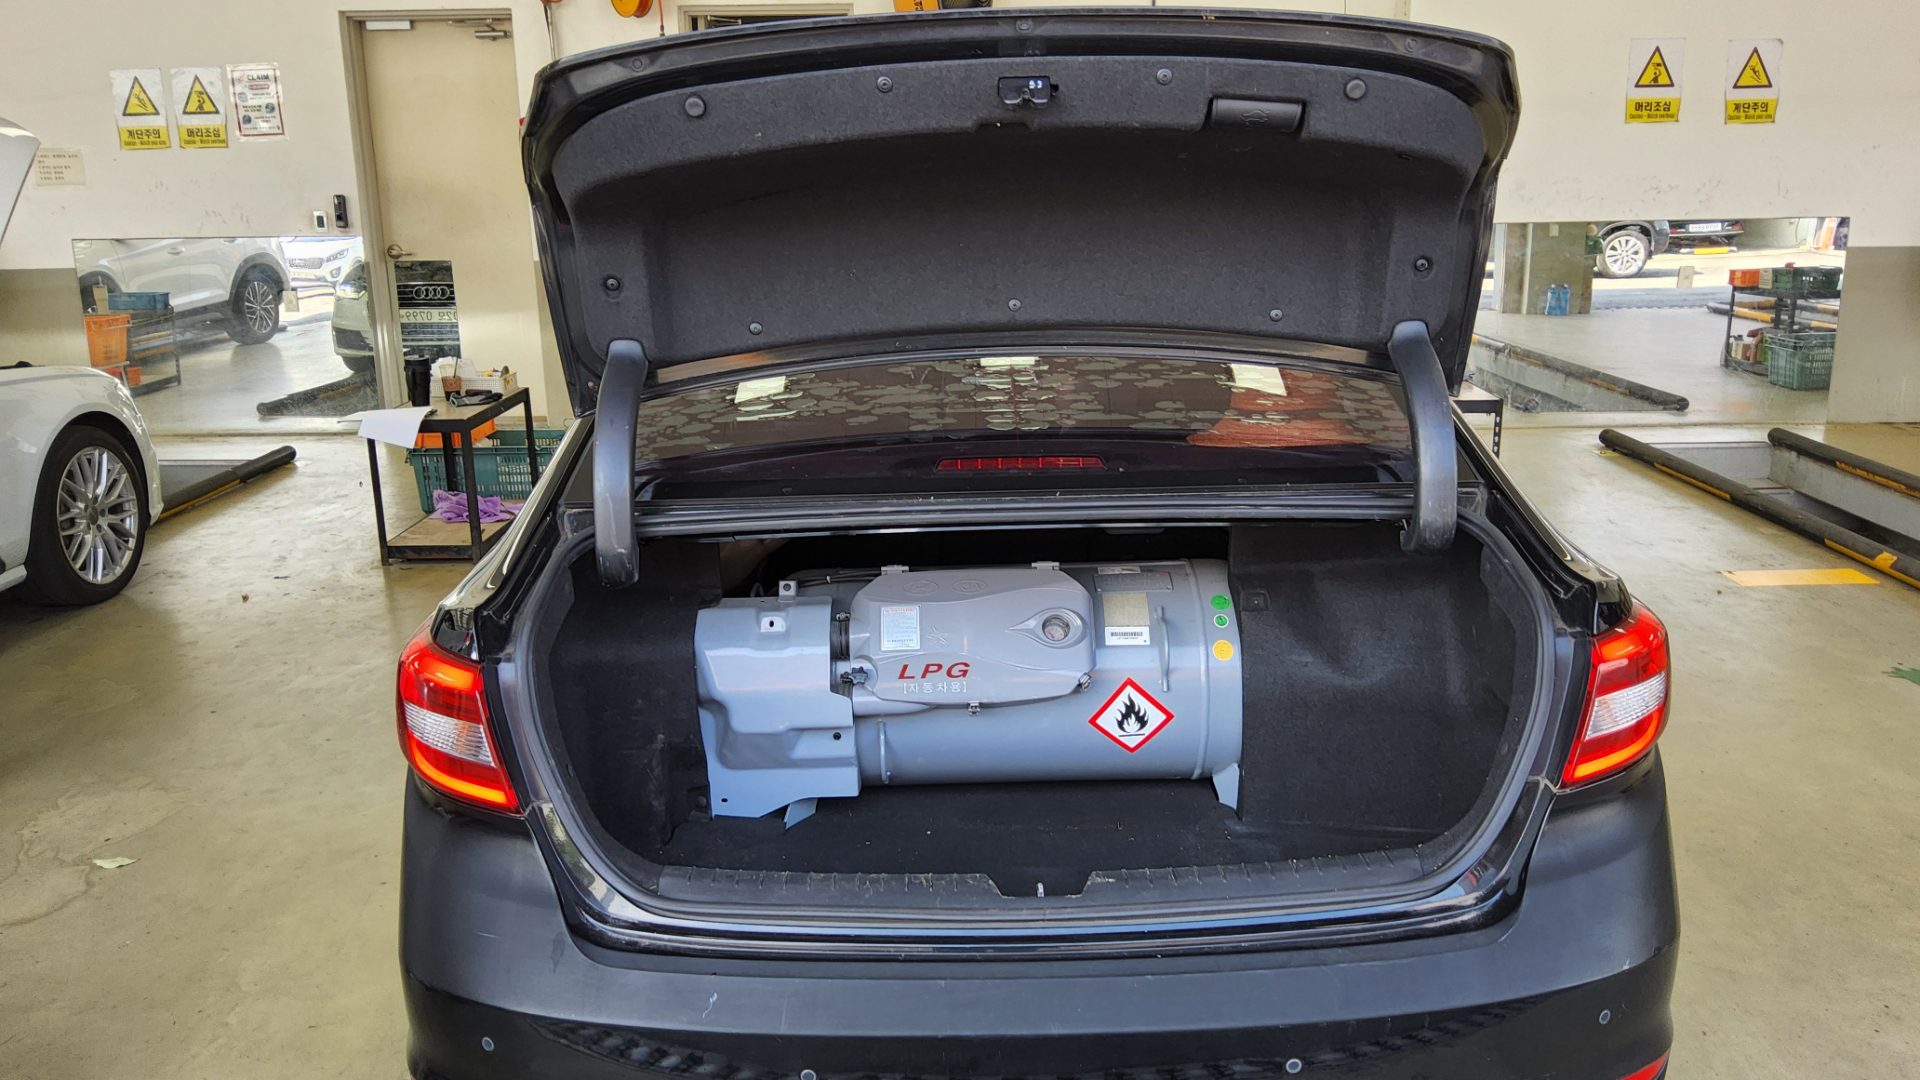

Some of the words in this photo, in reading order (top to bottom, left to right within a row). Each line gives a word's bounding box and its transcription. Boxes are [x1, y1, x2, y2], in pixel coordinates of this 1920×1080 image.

[1634, 101, 1671, 112] 머리조심
[1733, 102, 1769, 113] 계단주의
[127, 128, 161, 140] 계단주의
[186, 127, 221, 138] 머리조심
[898, 662, 970, 680] LPG
[903, 681, 967, 694] [자동차용]
